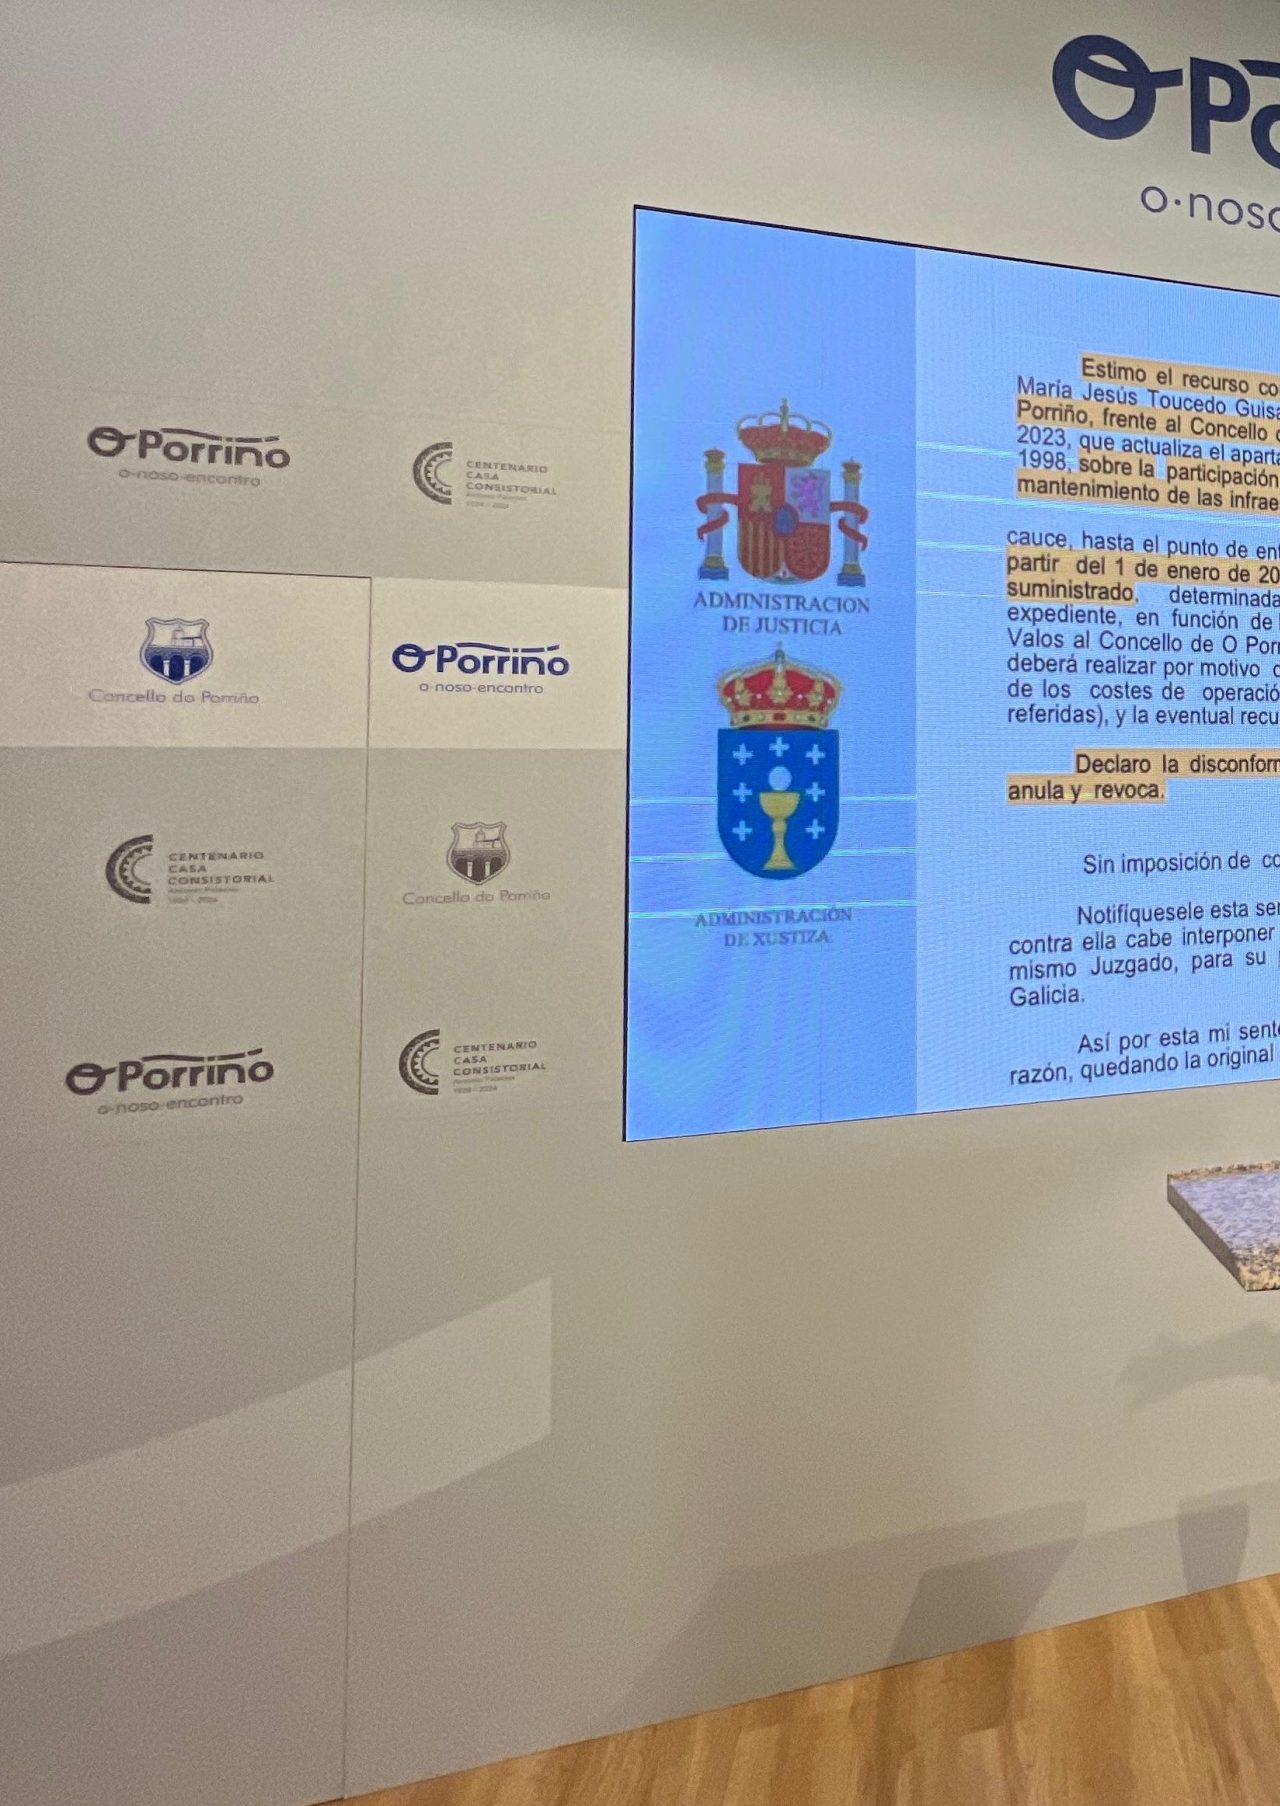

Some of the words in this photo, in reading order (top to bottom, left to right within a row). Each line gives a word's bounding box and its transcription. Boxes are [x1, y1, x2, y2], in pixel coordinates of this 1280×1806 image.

[1081, 357, 1147, 383] Estimo
[1155, 367, 1173, 386] el
[1182, 373, 1250, 394] recurso
[1017, 375, 1072, 400] María
[1082, 382, 1138, 406] Jesús
[1146, 388, 1227, 416] Toucedo
[1017, 398, 1094, 428] Porriño,
[1102, 406, 1157, 432] frente
[1165, 414, 1182, 433] al
[1190, 415, 1268, 442] Concello
[1006, 529, 1073, 552] cauce,
[1082, 530, 1135, 552] hasta
[1142, 534, 1159, 554] el
[1167, 538, 1219, 559] punto
[1225, 539, 1249, 560] de
[1006, 574, 1139, 603] suministrado,
[723, 615, 749, 633] DE
[754, 616, 843, 636] JUSTICIA
[1007, 703, 1109, 729] referidas),
[1115, 708, 1128, 729] y
[1132, 704, 1149, 725] la
[1154, 704, 1234, 726] eventual
[1075, 752, 1152, 774] Declaro
[1162, 753, 1179, 774] la
[1007, 779, 1065, 802] anula
[1069, 784, 1083, 805] y
[1094, 783, 1165, 800] revoca.
[1083, 853, 1115, 875] Sin
[1121, 851, 1223, 878] imposición
[1227, 849, 1251, 871] de
[1077, 900, 1205, 928] Notifíquesele
[1210, 899, 1249, 921] esta
[1008, 934, 1073, 955] contra
[1081, 930, 1117, 952] ella
[1125, 926, 1173, 949] cabe
[1181, 925, 1276, 949] interponer
[1008, 984, 1086, 1008] Galicia.
